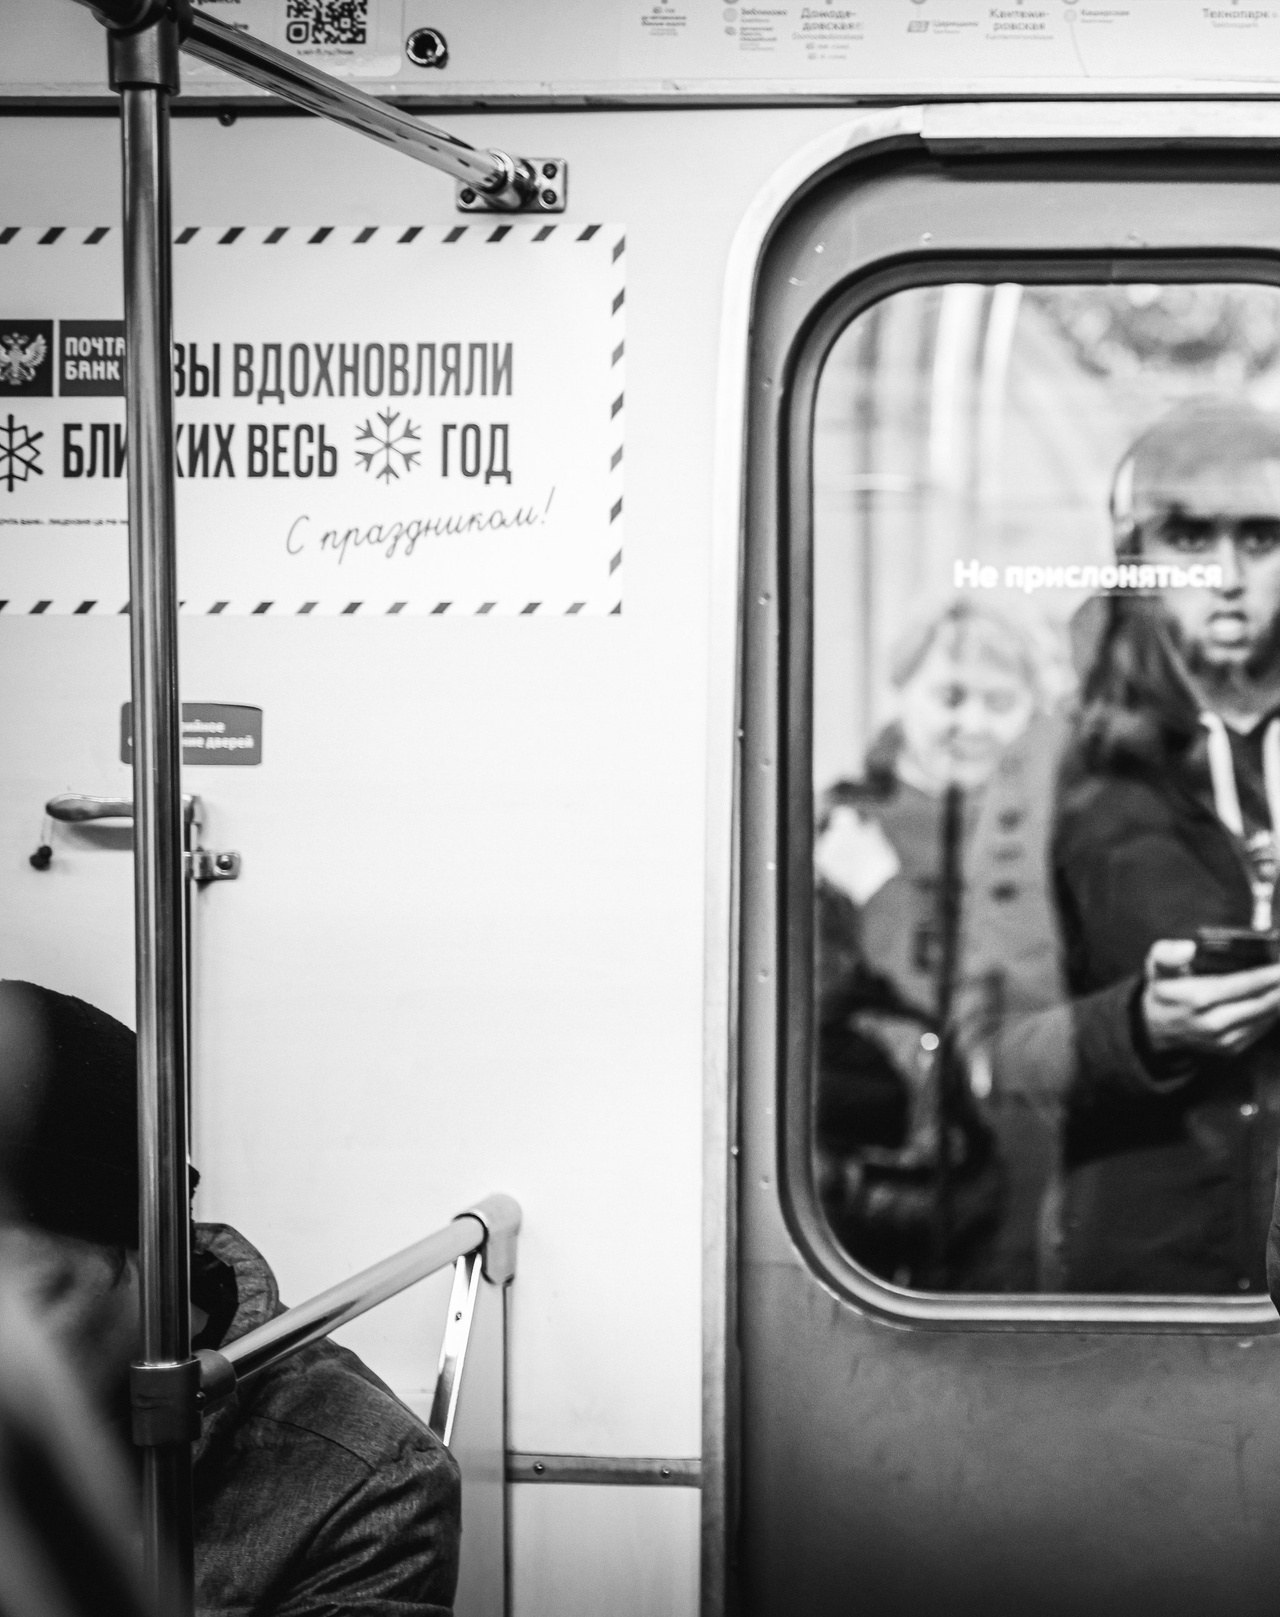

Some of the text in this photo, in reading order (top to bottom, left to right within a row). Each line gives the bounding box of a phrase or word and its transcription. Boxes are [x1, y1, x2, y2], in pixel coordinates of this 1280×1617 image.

[65, 336, 126, 357] ПОЧТА
[65, 360, 121, 381] БАНК
[233, 342, 514, 405] ВДОХНОВЛЯЛИ
[63, 422, 513, 485] БЛИИХ ВЕСЬ ГОД
[286, 486, 556, 566] С праздником!
[953, 557, 1223, 595] Не прислоняться
